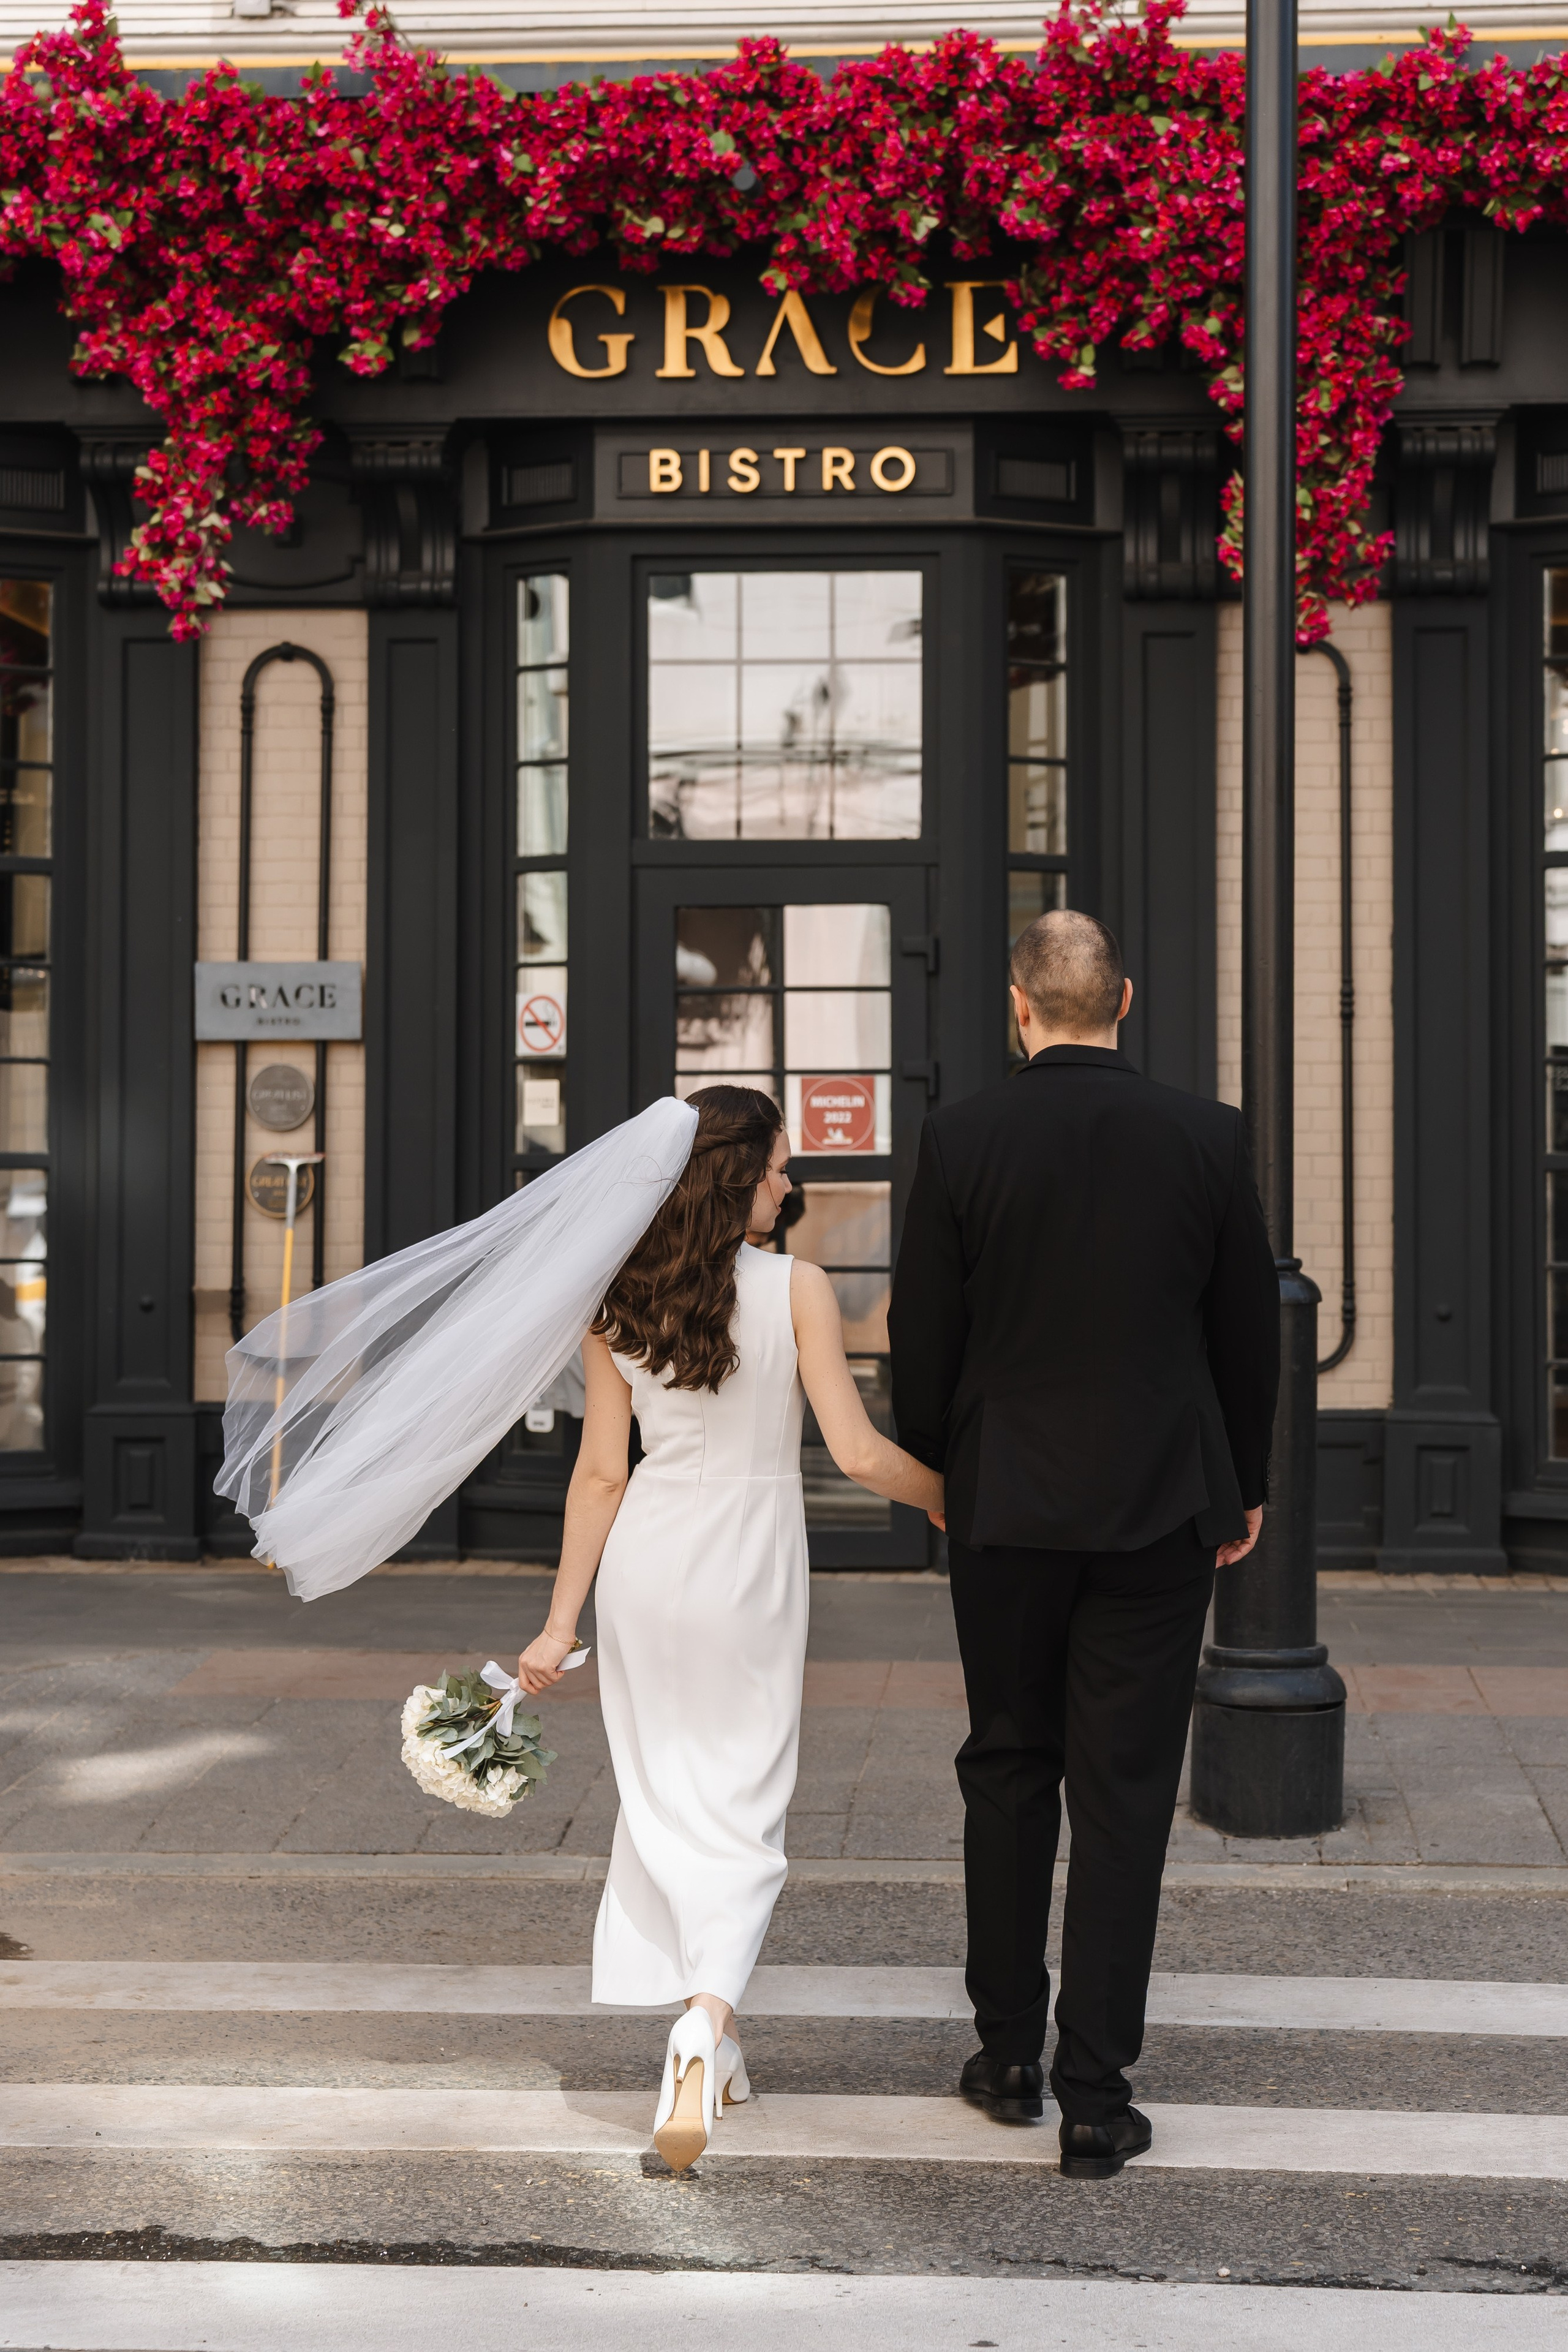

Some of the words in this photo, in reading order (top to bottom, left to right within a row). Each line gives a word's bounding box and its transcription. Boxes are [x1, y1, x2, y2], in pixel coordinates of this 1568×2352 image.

[548, 282, 1019, 379] GRACE
[649, 446, 916, 492] BISTRO
[221, 982, 336, 1009] GRACE
[810, 1095, 865, 1108] MICHELIN
